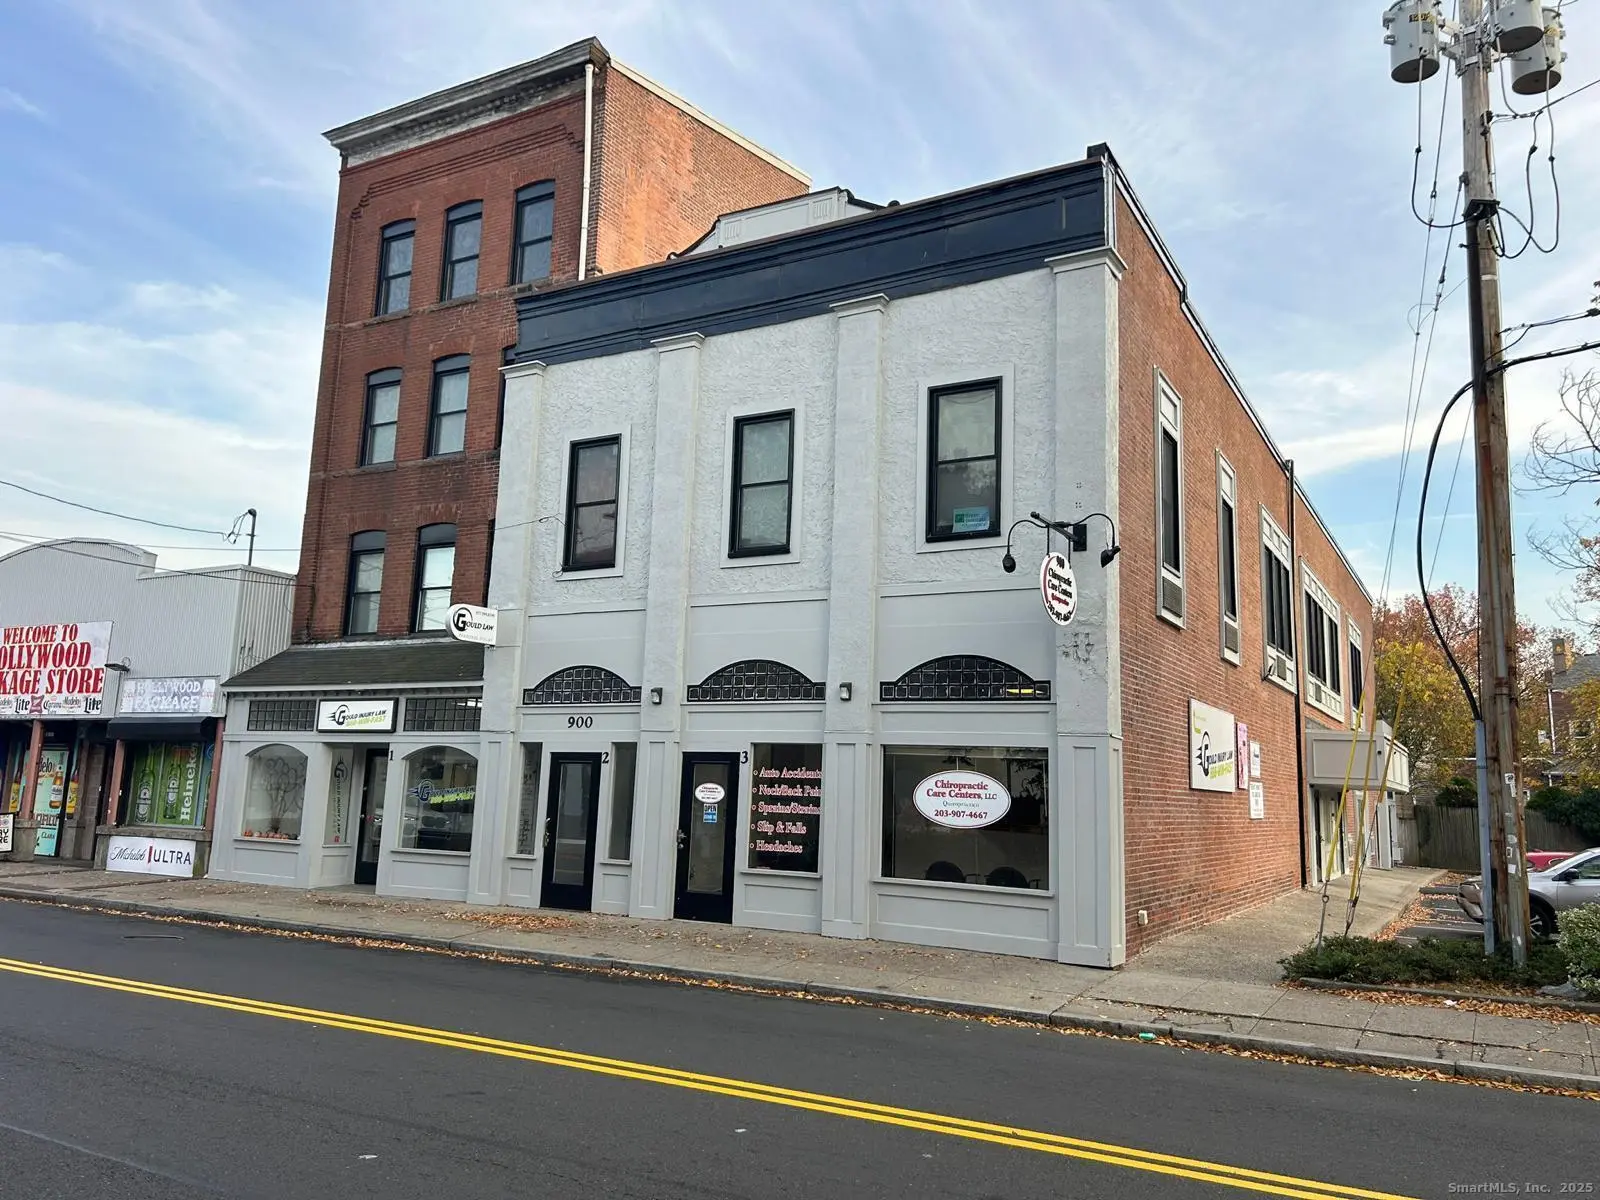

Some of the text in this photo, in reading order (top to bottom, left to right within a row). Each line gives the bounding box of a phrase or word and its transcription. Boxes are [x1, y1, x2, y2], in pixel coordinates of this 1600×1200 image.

[453, 607, 495, 631] GOULD LAW
[3, 623, 79, 645] WELCOME TO
[0, 642, 92, 670] OLLYWOOD
[0, 668, 105, 695] KAGE STORE
[137, 681, 200, 693] HLLYWOOD
[15, 697, 30, 714] Lite
[84, 697, 102, 714] Lite
[567, 716, 593, 729] 900
[389, 750, 394, 761] 1
[601, 751, 610, 764] 2
[740, 750, 749, 764] 3
[759, 766, 780, 778] Auto
[181, 746, 198, 820] Heineke
[935, 780, 988, 791] Chiropractic
[758, 784, 802, 797] Neck/Back
[926, 789, 947, 798] Care
[948, 789, 983, 800] Centers,
[934, 809, 988, 819] 203-907-4667
[756, 820, 807, 835] Slip & Falls
[755, 840, 803, 853] Headaches
[111, 846, 192, 865] Michelob ULTRA
